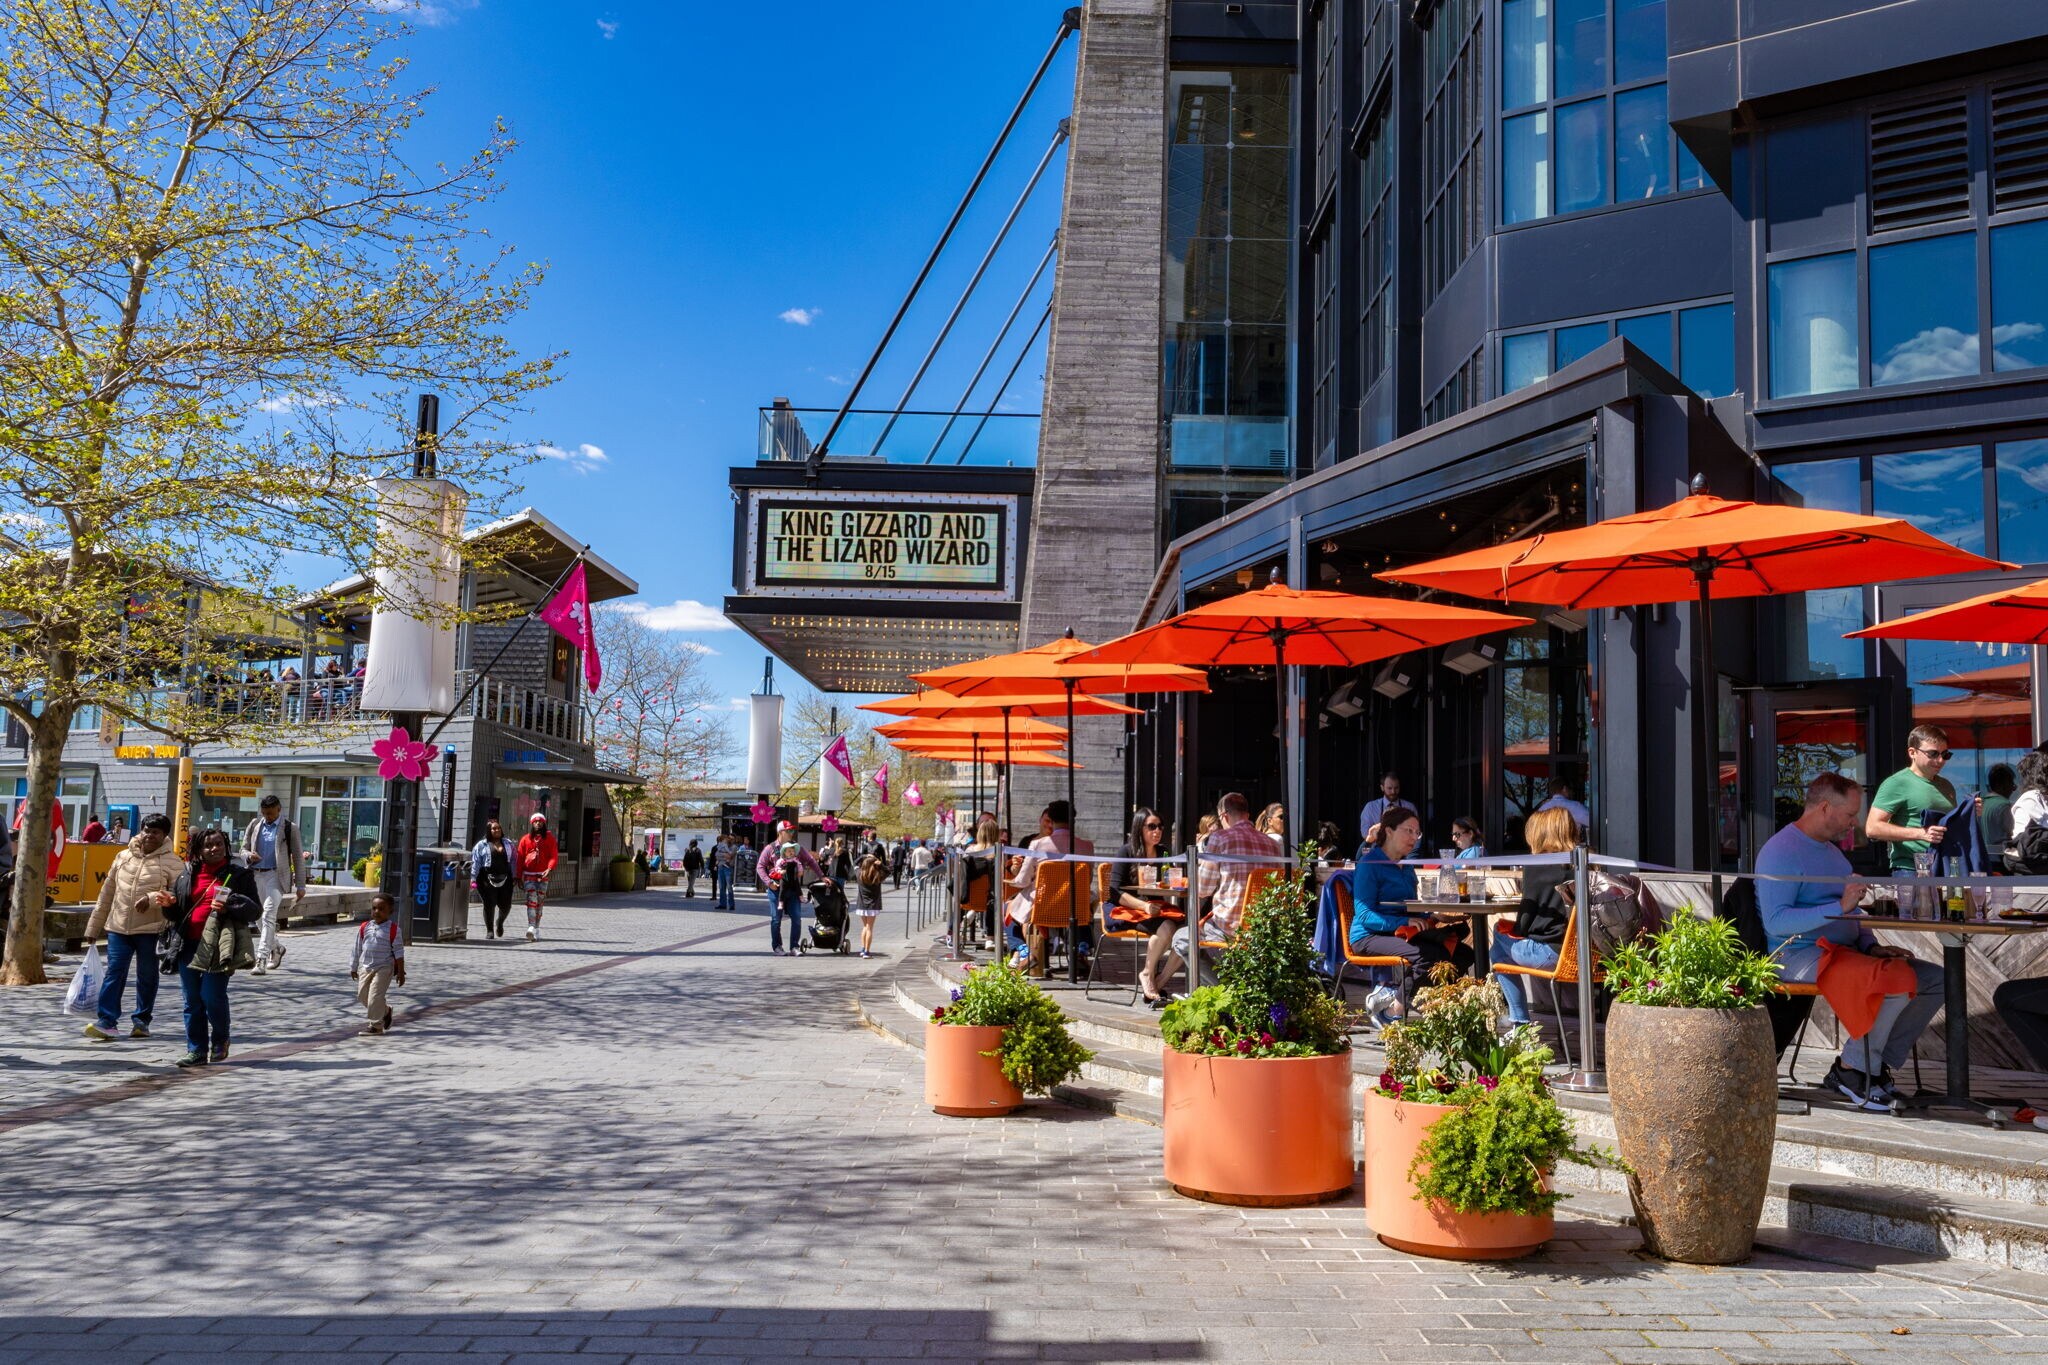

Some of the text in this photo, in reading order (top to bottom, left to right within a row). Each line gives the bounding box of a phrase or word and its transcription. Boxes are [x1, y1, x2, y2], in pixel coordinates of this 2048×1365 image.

[780, 511, 986, 540] KING GIZZARD AND
[773, 536, 991, 566] THE LIZARD WIZARD
[864, 564, 897, 579] 8/15
[211, 775, 262, 785] WATER TAXI
[441, 762, 453, 809] Emergency
[180, 789, 192, 833] WATER
[414, 863, 430, 905] clean
